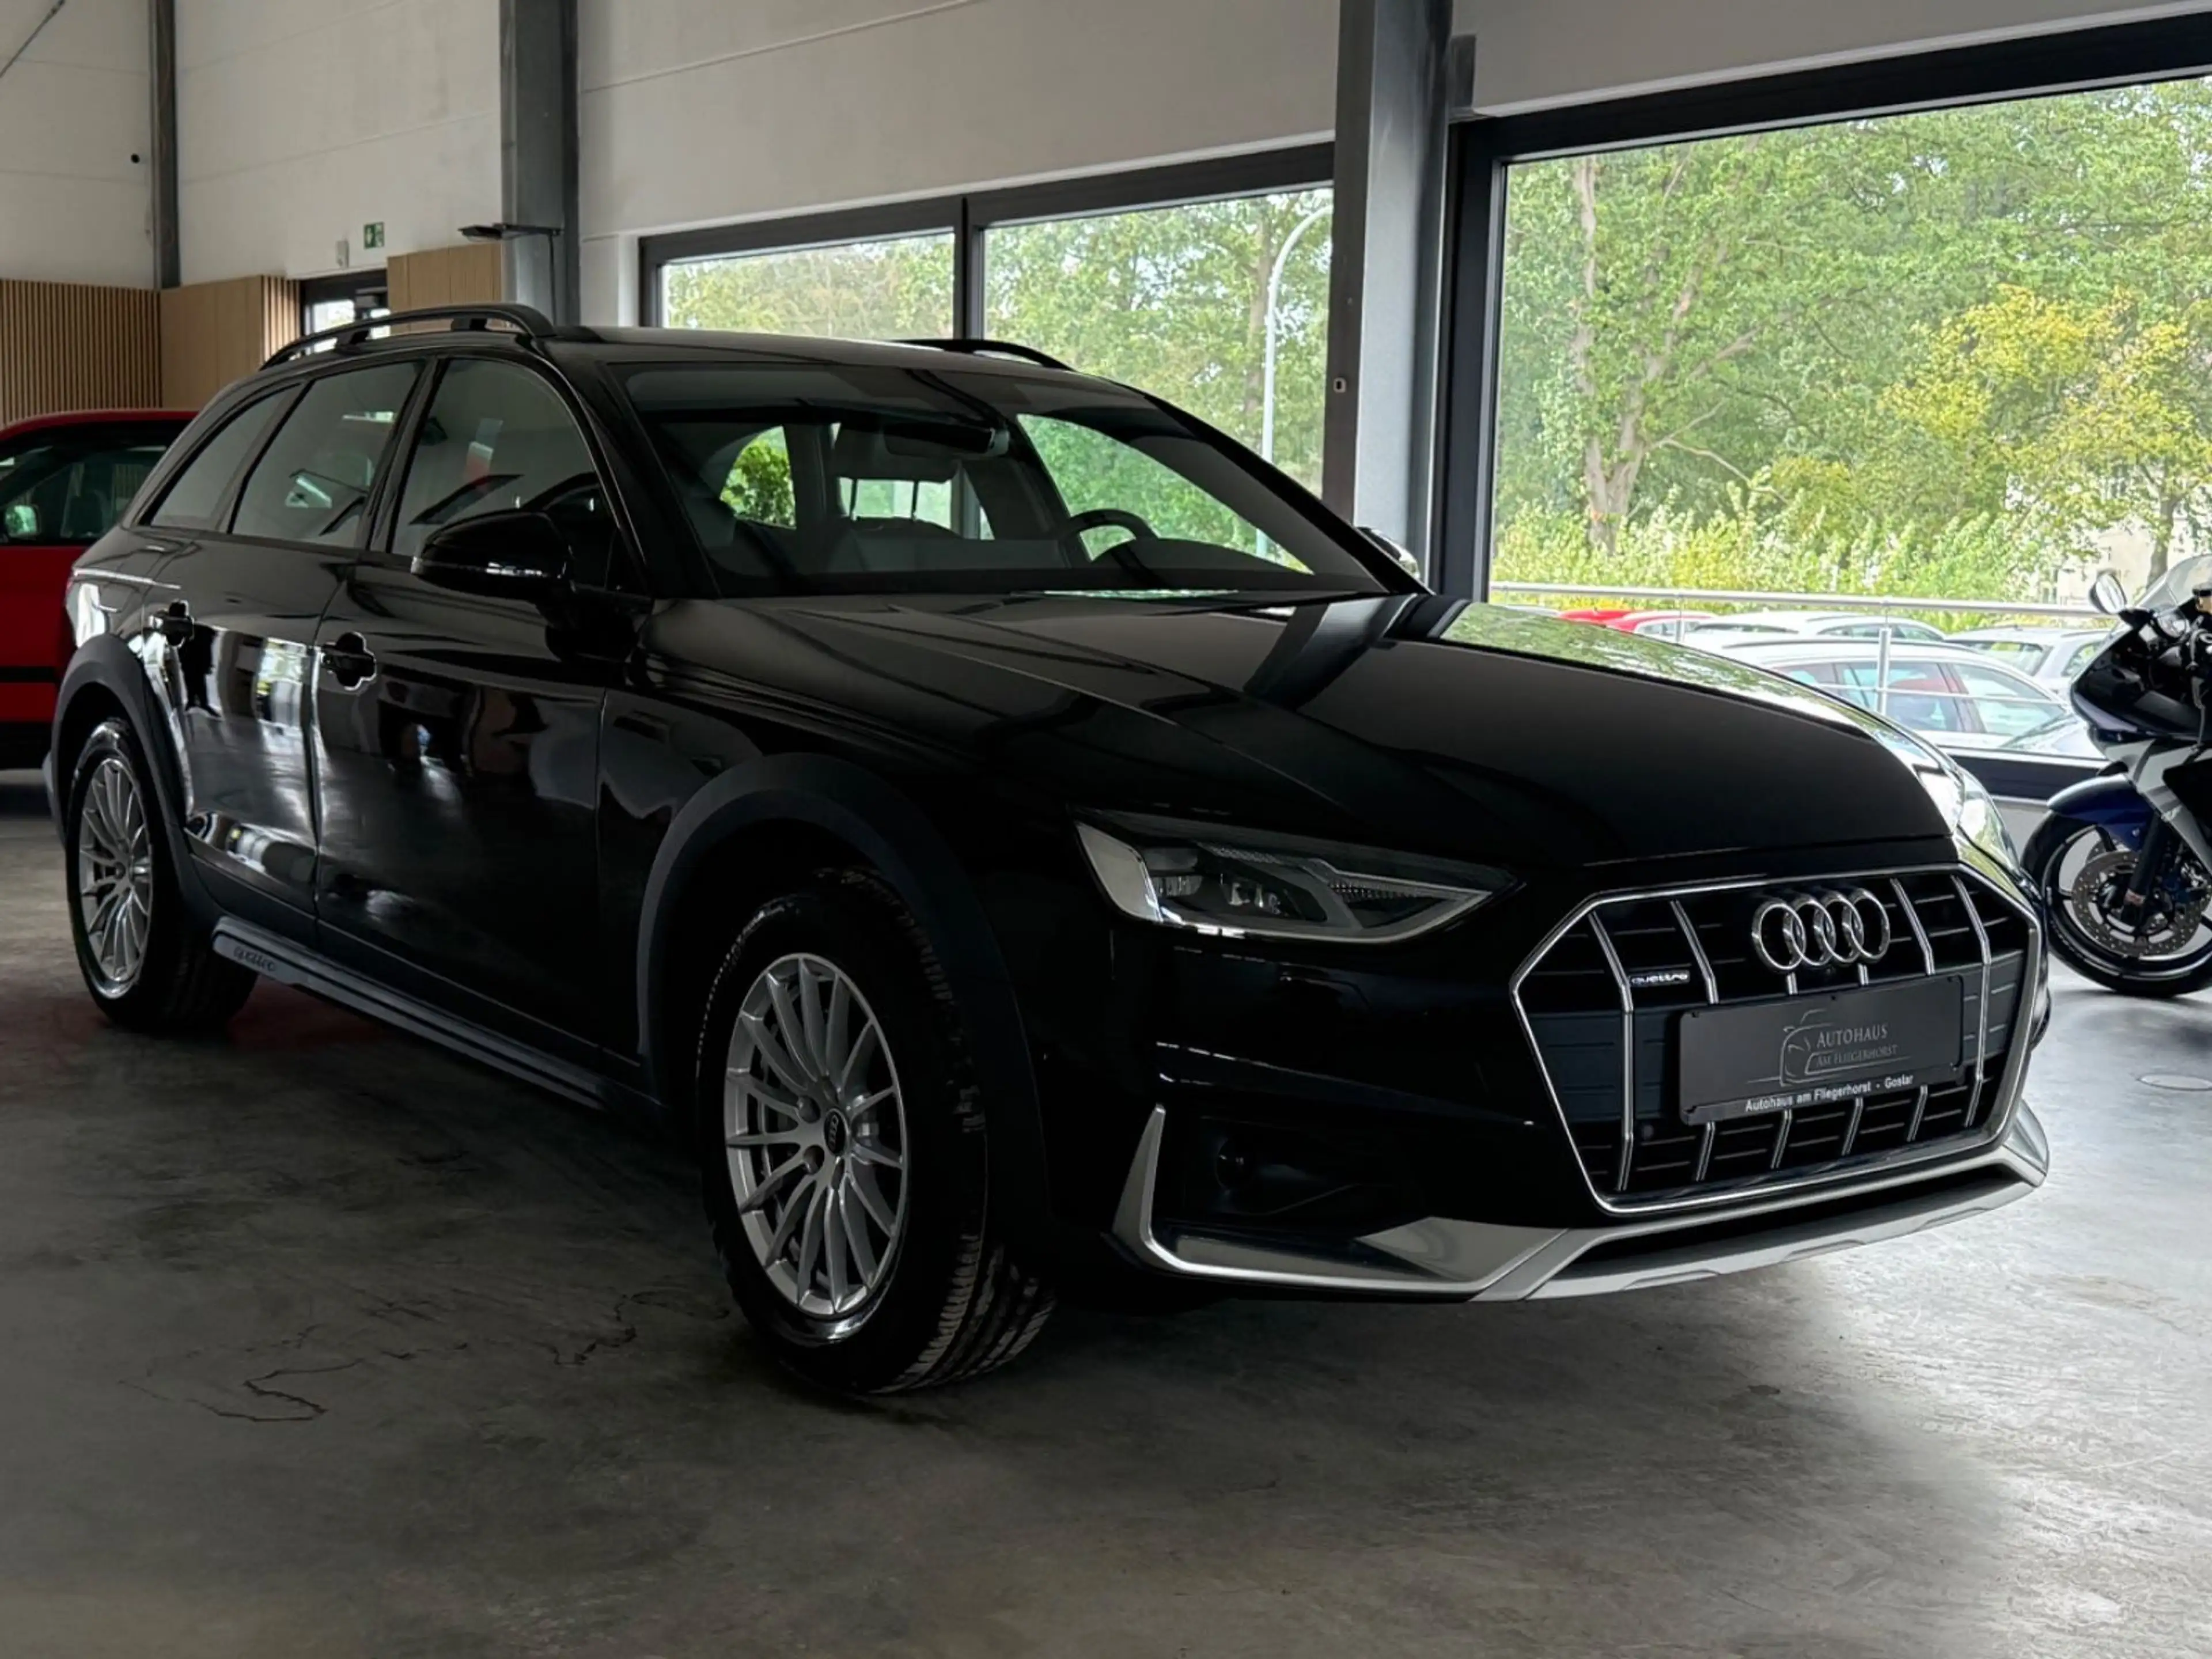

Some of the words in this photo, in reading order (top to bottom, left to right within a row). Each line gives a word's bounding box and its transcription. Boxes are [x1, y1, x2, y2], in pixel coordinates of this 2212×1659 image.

[1816, 1023, 1888, 1048] AUTOHAUS
[1745, 1094, 1793, 1112] Autohaus
[1797, 1093, 1812, 1103] am
[1815, 1081, 1871, 1101] Fliegerhorst
[1884, 1074, 1914, 1088] Goslar
